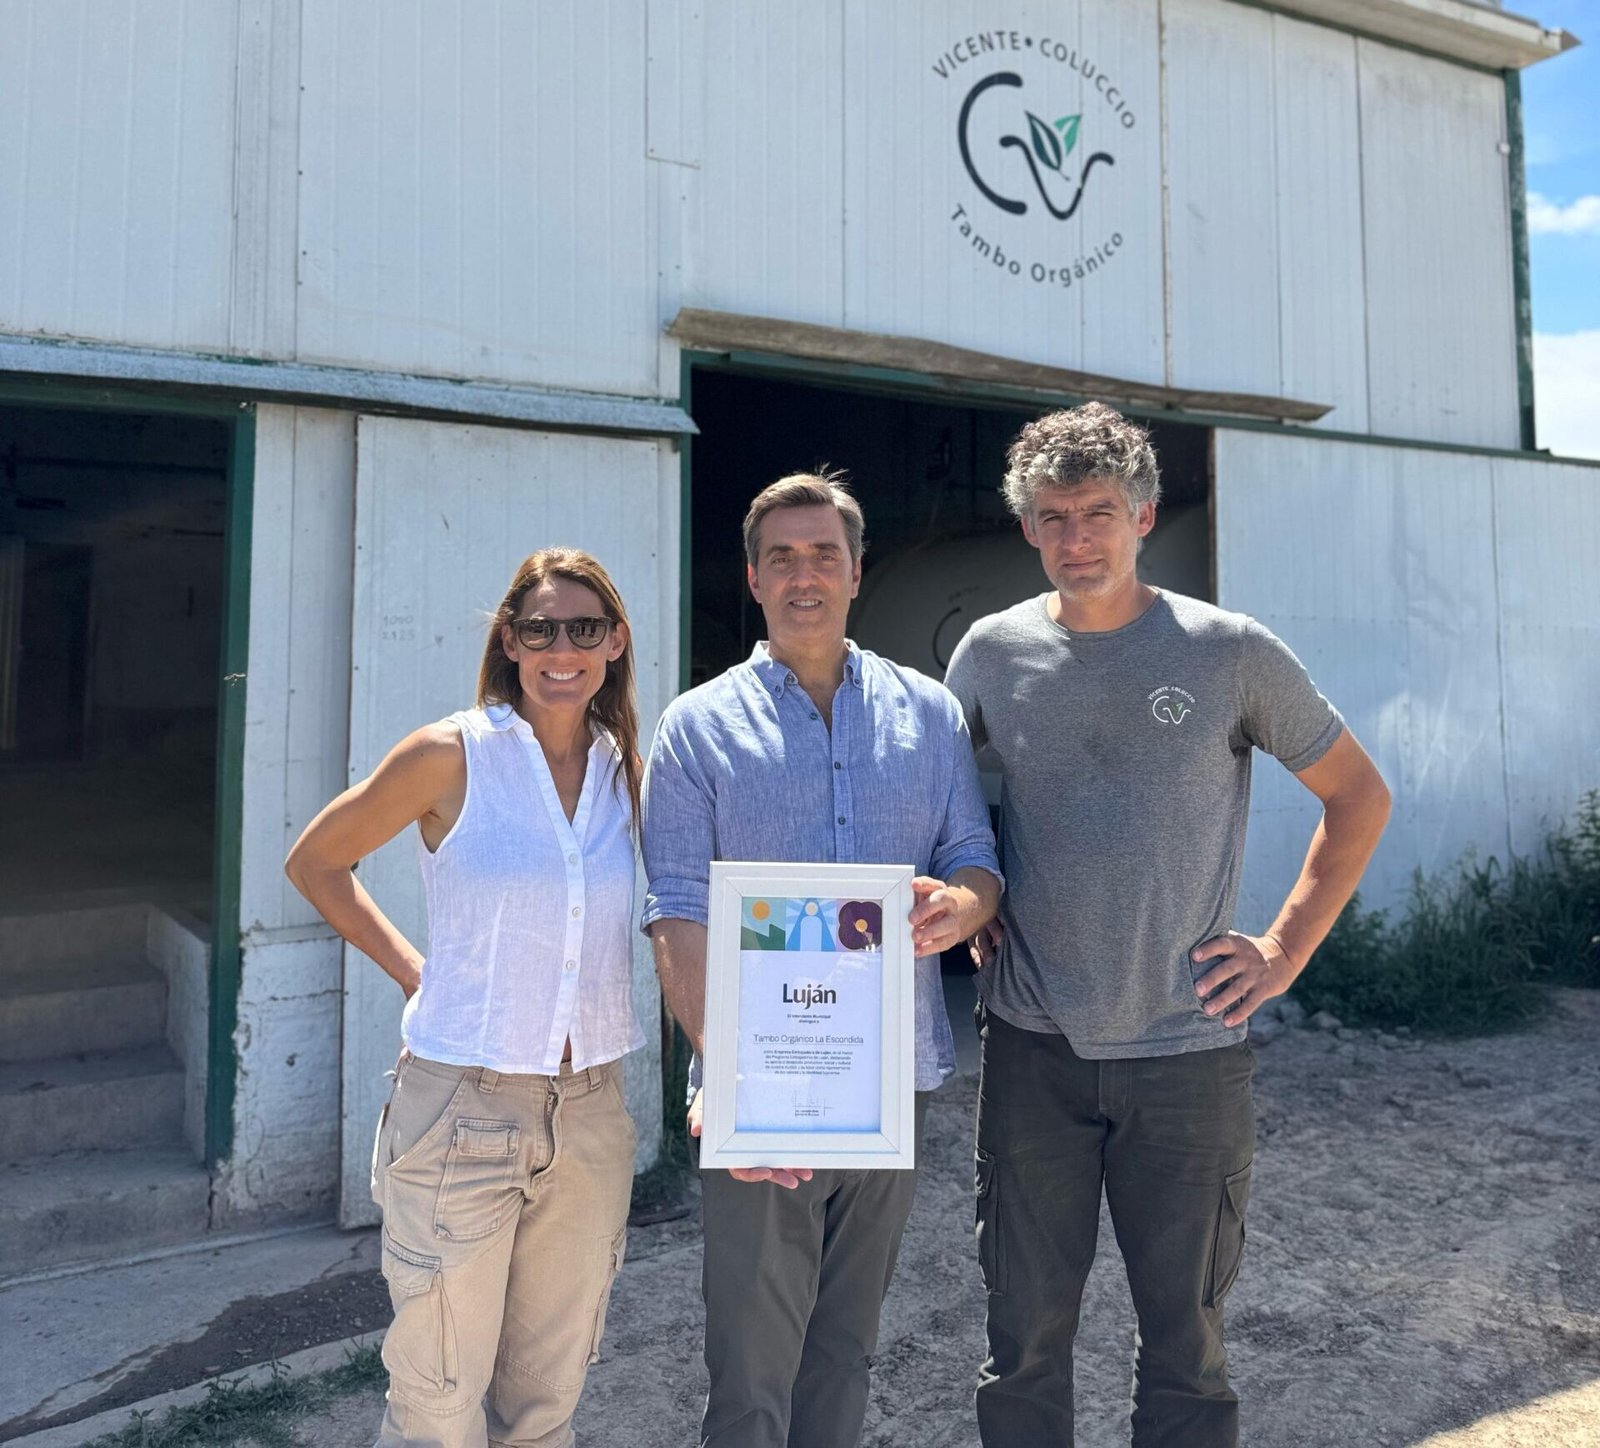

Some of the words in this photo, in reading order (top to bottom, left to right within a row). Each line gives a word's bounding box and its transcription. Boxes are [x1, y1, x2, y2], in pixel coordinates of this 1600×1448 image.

[932, 31, 1021, 80] VICENTE
[1039, 37, 1135, 129] COLUCCIO
[951, 203, 1021, 275] Tambo
[1030, 231, 1123, 287] Orgánico
[1147, 686, 1169, 700] VICENTE
[1170, 686, 1196, 703] COLUCCIO
[782, 983, 837, 1010] Luján
[753, 1034, 779, 1042] Tambo
[781, 1034, 815, 1044] Orgánico
[815, 1035, 824, 1043] La
[826, 1035, 864, 1044] Escondida
